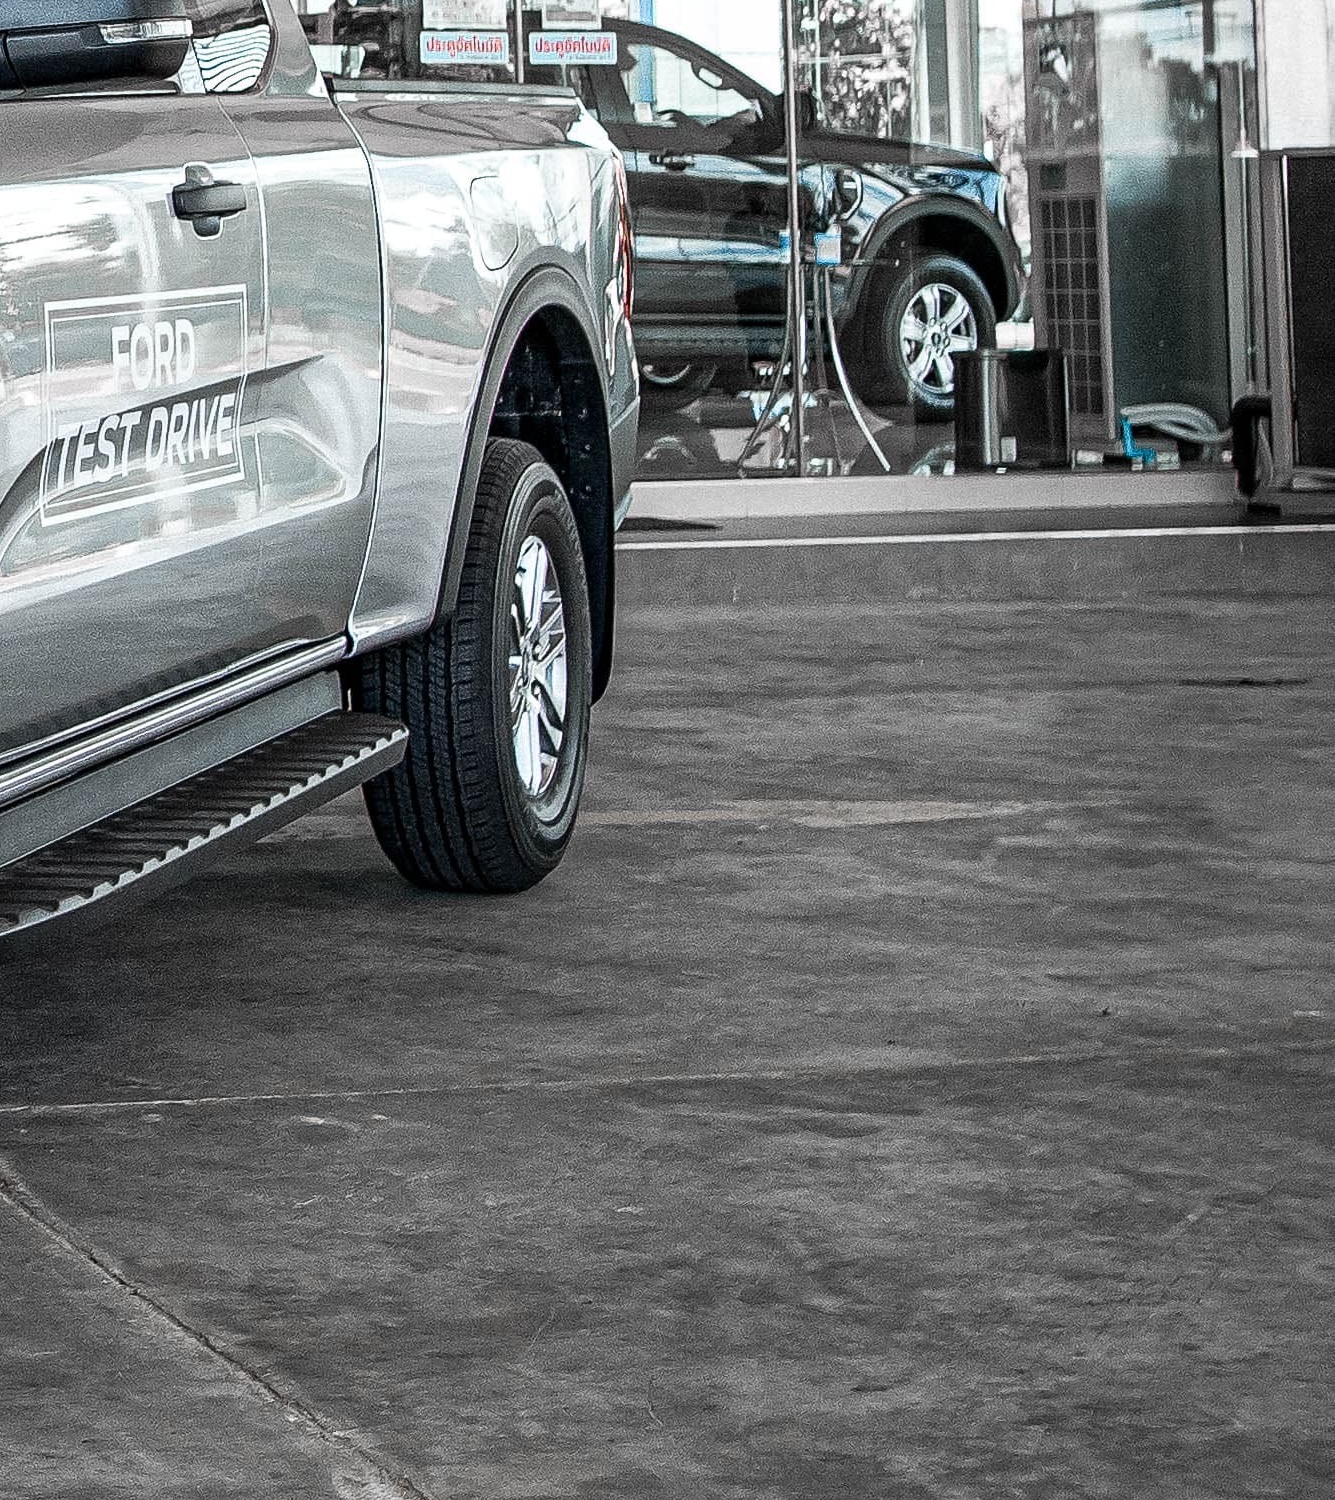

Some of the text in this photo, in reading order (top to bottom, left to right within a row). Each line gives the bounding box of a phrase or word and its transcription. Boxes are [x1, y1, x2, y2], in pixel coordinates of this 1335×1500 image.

[111, 318, 196, 393] FORD
[55, 392, 235, 491] TEST DRIVE
